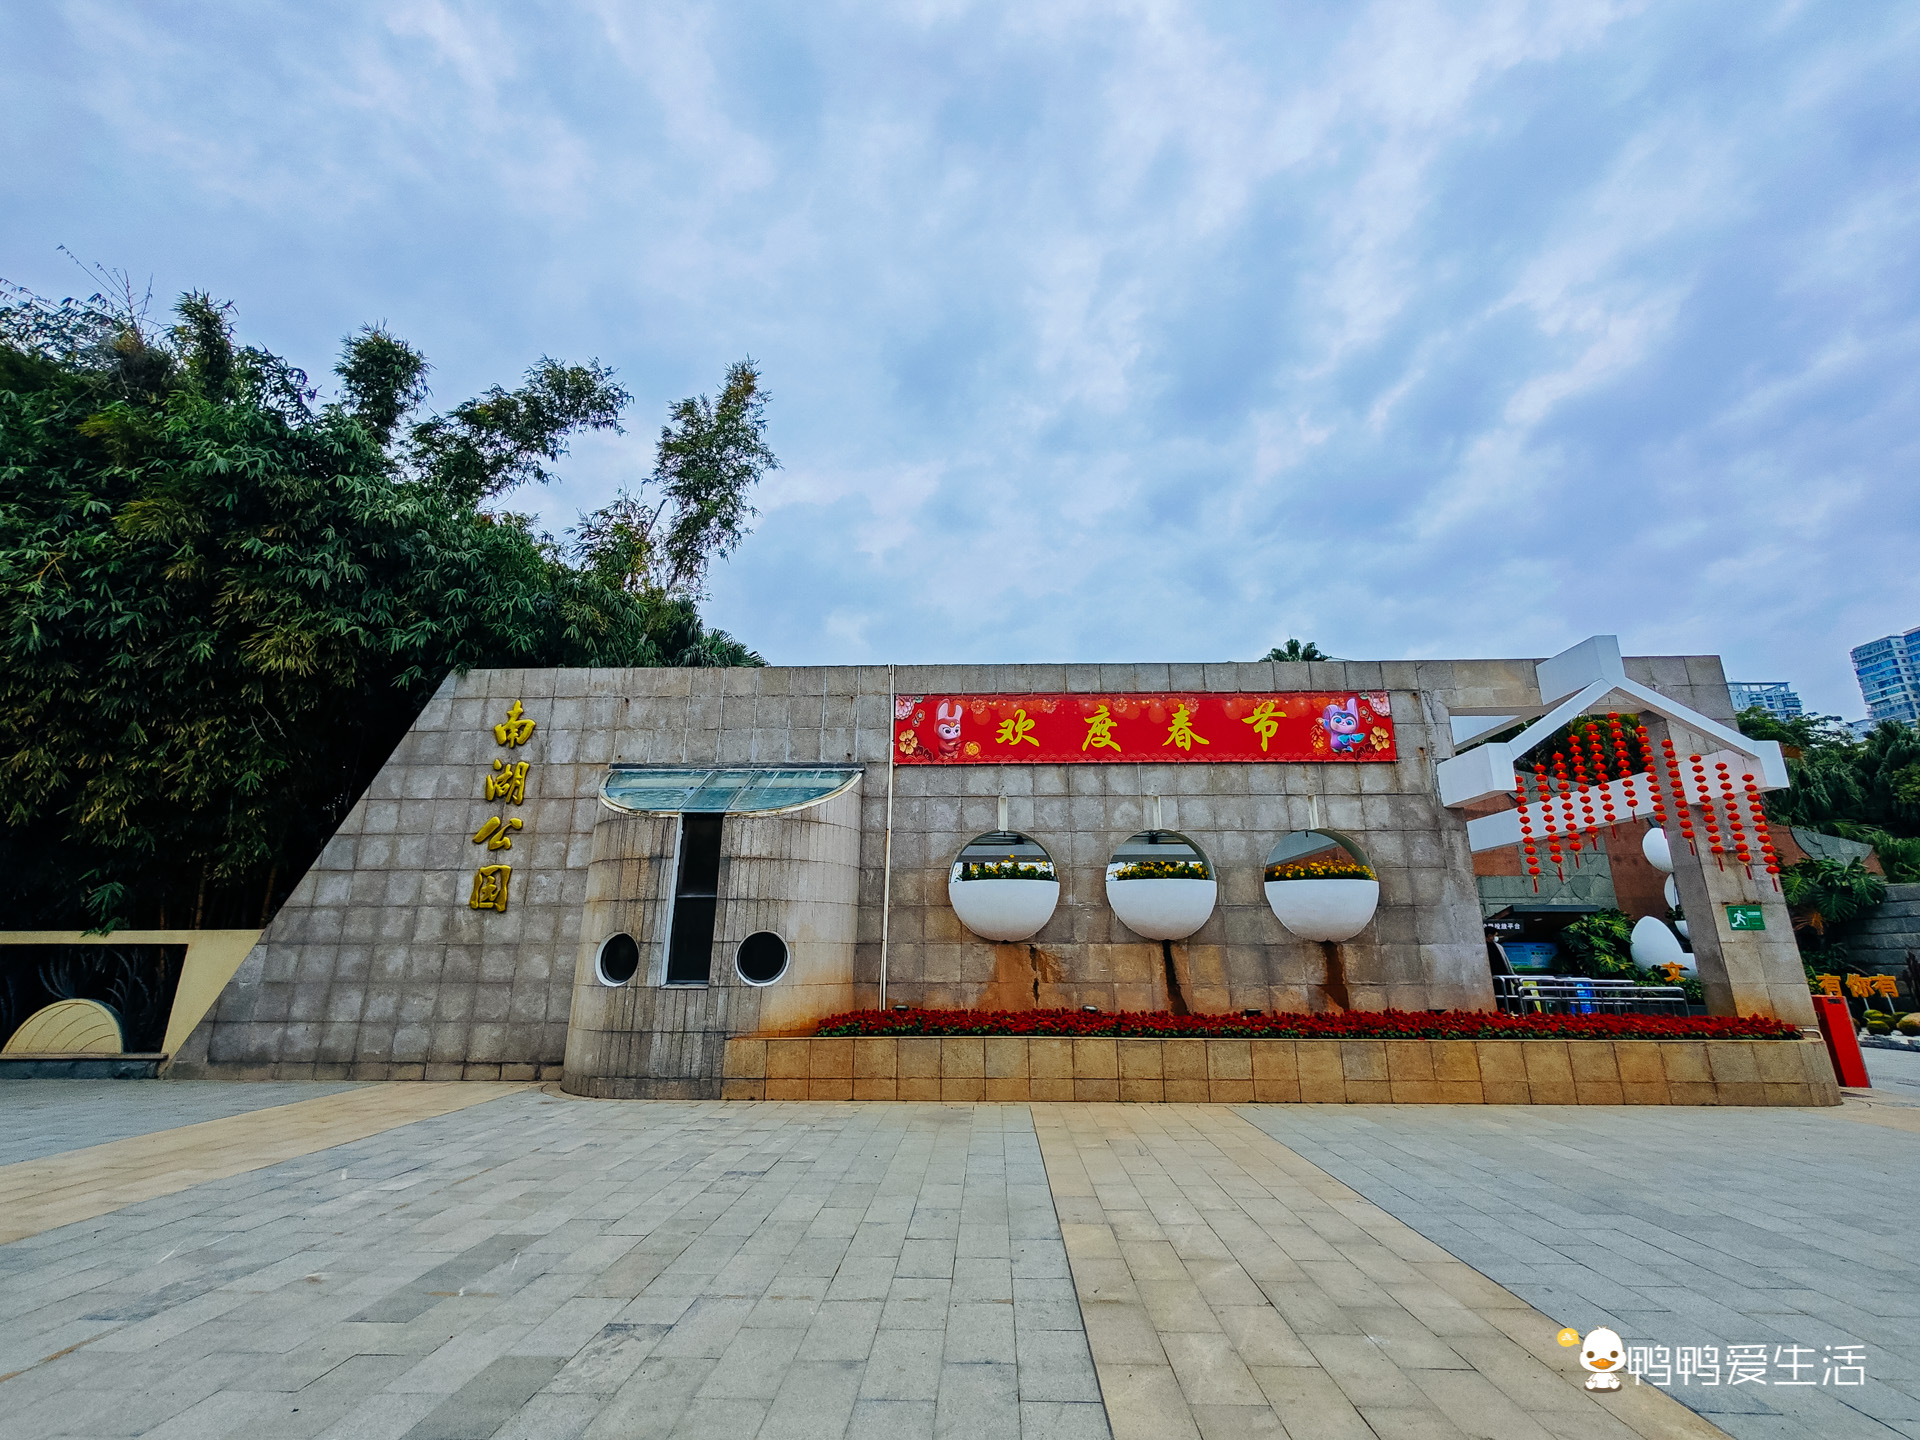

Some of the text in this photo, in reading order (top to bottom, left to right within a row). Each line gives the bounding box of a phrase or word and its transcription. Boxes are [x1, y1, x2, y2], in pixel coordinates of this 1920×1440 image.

[995, 703, 1288, 753] 欢度春节
[469, 699, 537, 912] 南湖公园
[1483, 922, 1521, 930] 投放平台
[1661, 961, 1900, 998] 文 有你有
